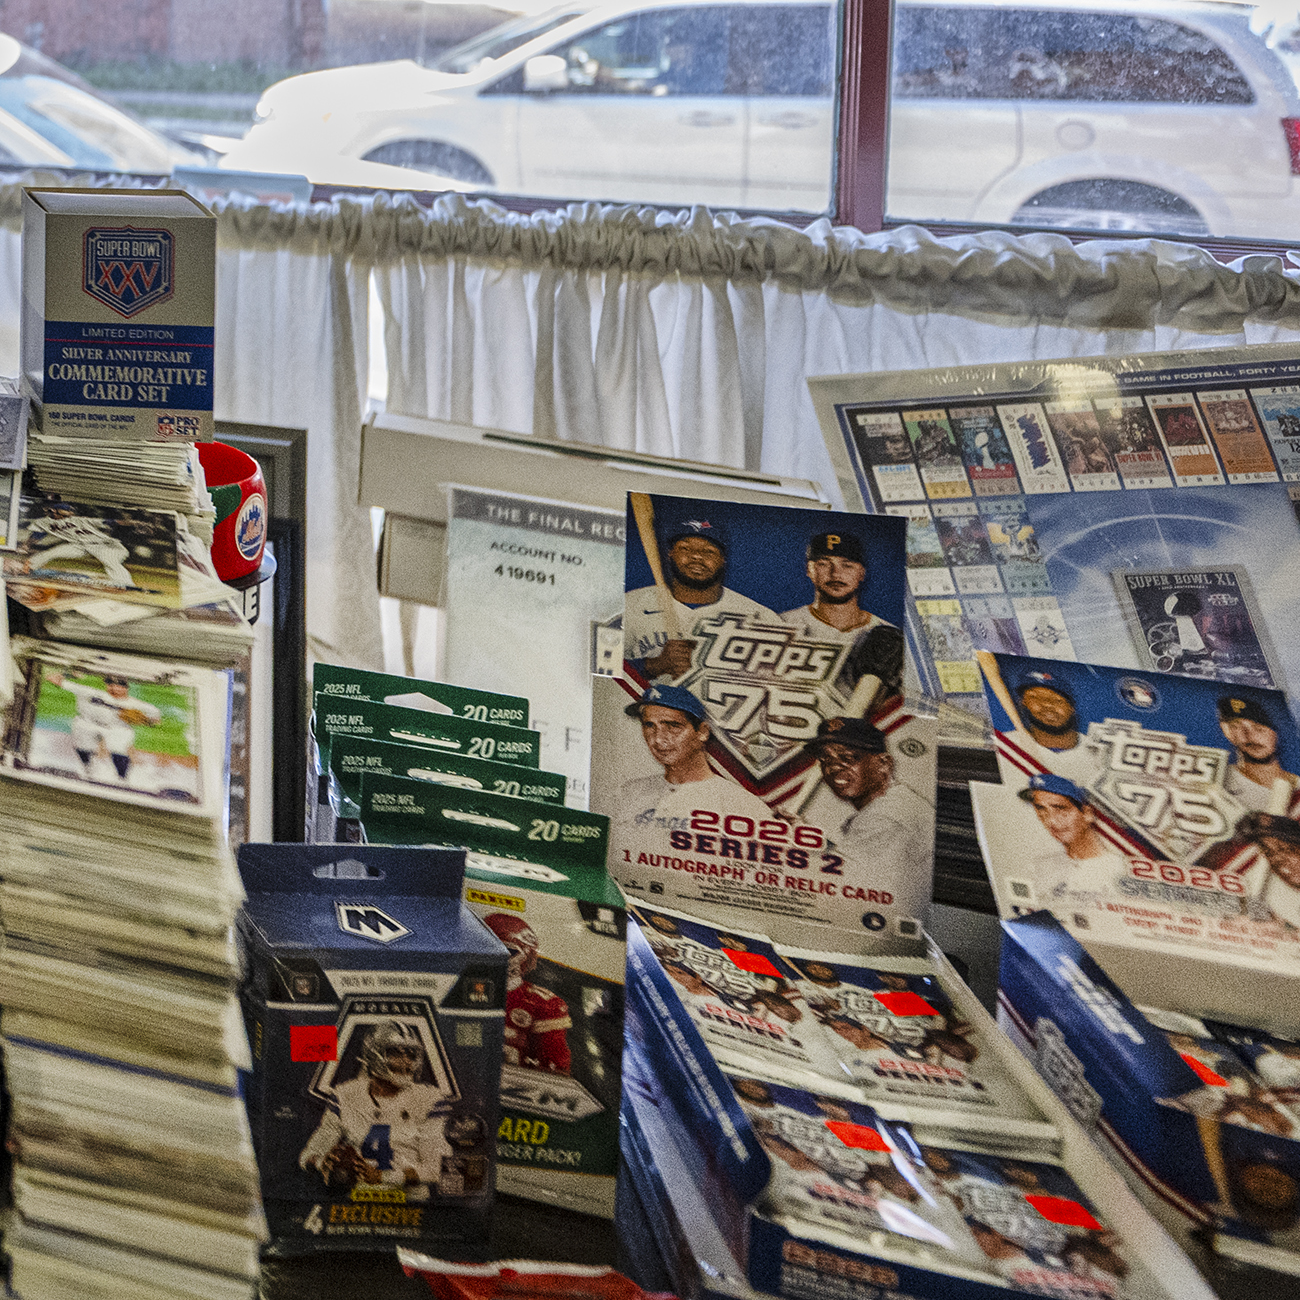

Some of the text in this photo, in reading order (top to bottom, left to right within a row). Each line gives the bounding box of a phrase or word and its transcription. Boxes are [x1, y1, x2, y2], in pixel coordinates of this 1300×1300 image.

[97, 241, 161, 258] SUPER BOWL
[99, 261, 160, 298] XXV
[82, 327, 174, 340] LIMITED EDITION
[62, 347, 193, 364] SILVER ANNIVERSARY
[49, 363, 207, 386] COMMEMORATIVE
[82, 384, 170, 402] CARD SET
[62, 413, 87, 421] SUPER
[88, 414, 109, 422] BOWL
[110, 415, 135, 423] CARDS
[175, 416, 199, 426] PRO
[175, 426, 200, 436] SET
[486, 504, 584, 534] THE FINAL
[827, 534, 841, 551] P
[490, 540, 587, 567] ACCOUNT NO.
[1127, 574, 1170, 590] SUPER
[1173, 573, 1212, 587] BOWL
[1216, 572, 1236, 587] XL
[323, 683, 362, 695] 2025 NFL
[463, 705, 524, 722] 20 CARDS
[706, 679, 822, 741] 75
[325, 714, 365, 726] 2025 NFL
[326, 724, 373, 734] TRADING CARDS
[468, 737, 533, 758] 20 CARDS
[342, 756, 382, 767] 2025 NFL
[493, 780, 560, 799] 20 CARDS
[1116, 781, 1229, 838] 75
[527, 819, 602, 841] 20 CARDS
[690, 809, 824, 849] 2026
[670, 830, 844, 876] SERIES 2
[622, 849, 632, 863] 1
[637, 851, 745, 882] AUTOGRAPH
[755, 870, 778, 885] OR
[785, 875, 837, 897] RELIC
[841, 884, 895, 906] CARD
[1130, 858, 1245, 894] 2026
[468, 890, 522, 908] PANINI
[352, 1001, 422, 1015] MOSAIC
[362, 1124, 395, 1171] 4
